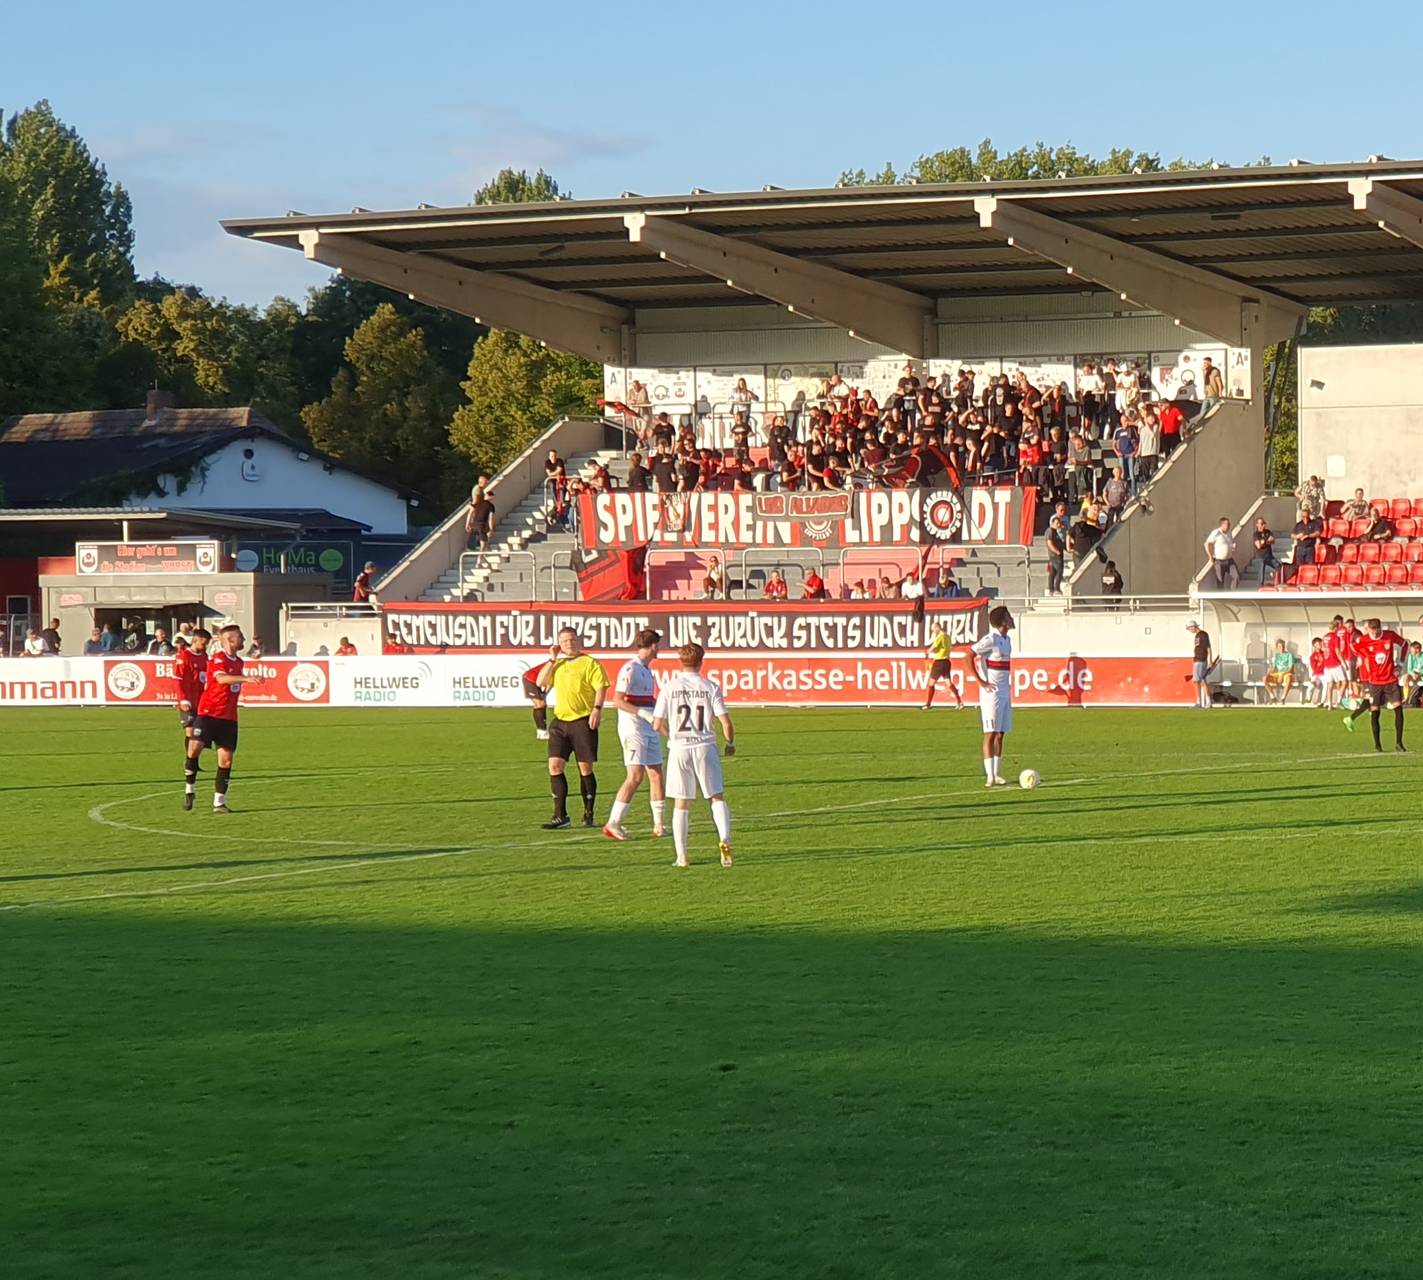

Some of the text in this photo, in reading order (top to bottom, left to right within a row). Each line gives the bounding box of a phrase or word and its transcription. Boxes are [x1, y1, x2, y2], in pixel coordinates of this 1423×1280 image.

[1235, 351, 1245, 367] A
[387, 613, 498, 646] GEMEINSAM
[499, 610, 535, 647] FÜR
[668, 616, 702, 648] NIE
[707, 611, 788, 648] ZURÜCK
[793, 616, 861, 649] STETS
[864, 615, 919, 649] NACH
[354, 676, 420, 689] HELLWEG
[452, 676, 519, 689] HELLWEG
[354, 690, 397, 702] RADIO
[453, 690, 496, 702] RADIO
[677, 704, 705, 733] 21
